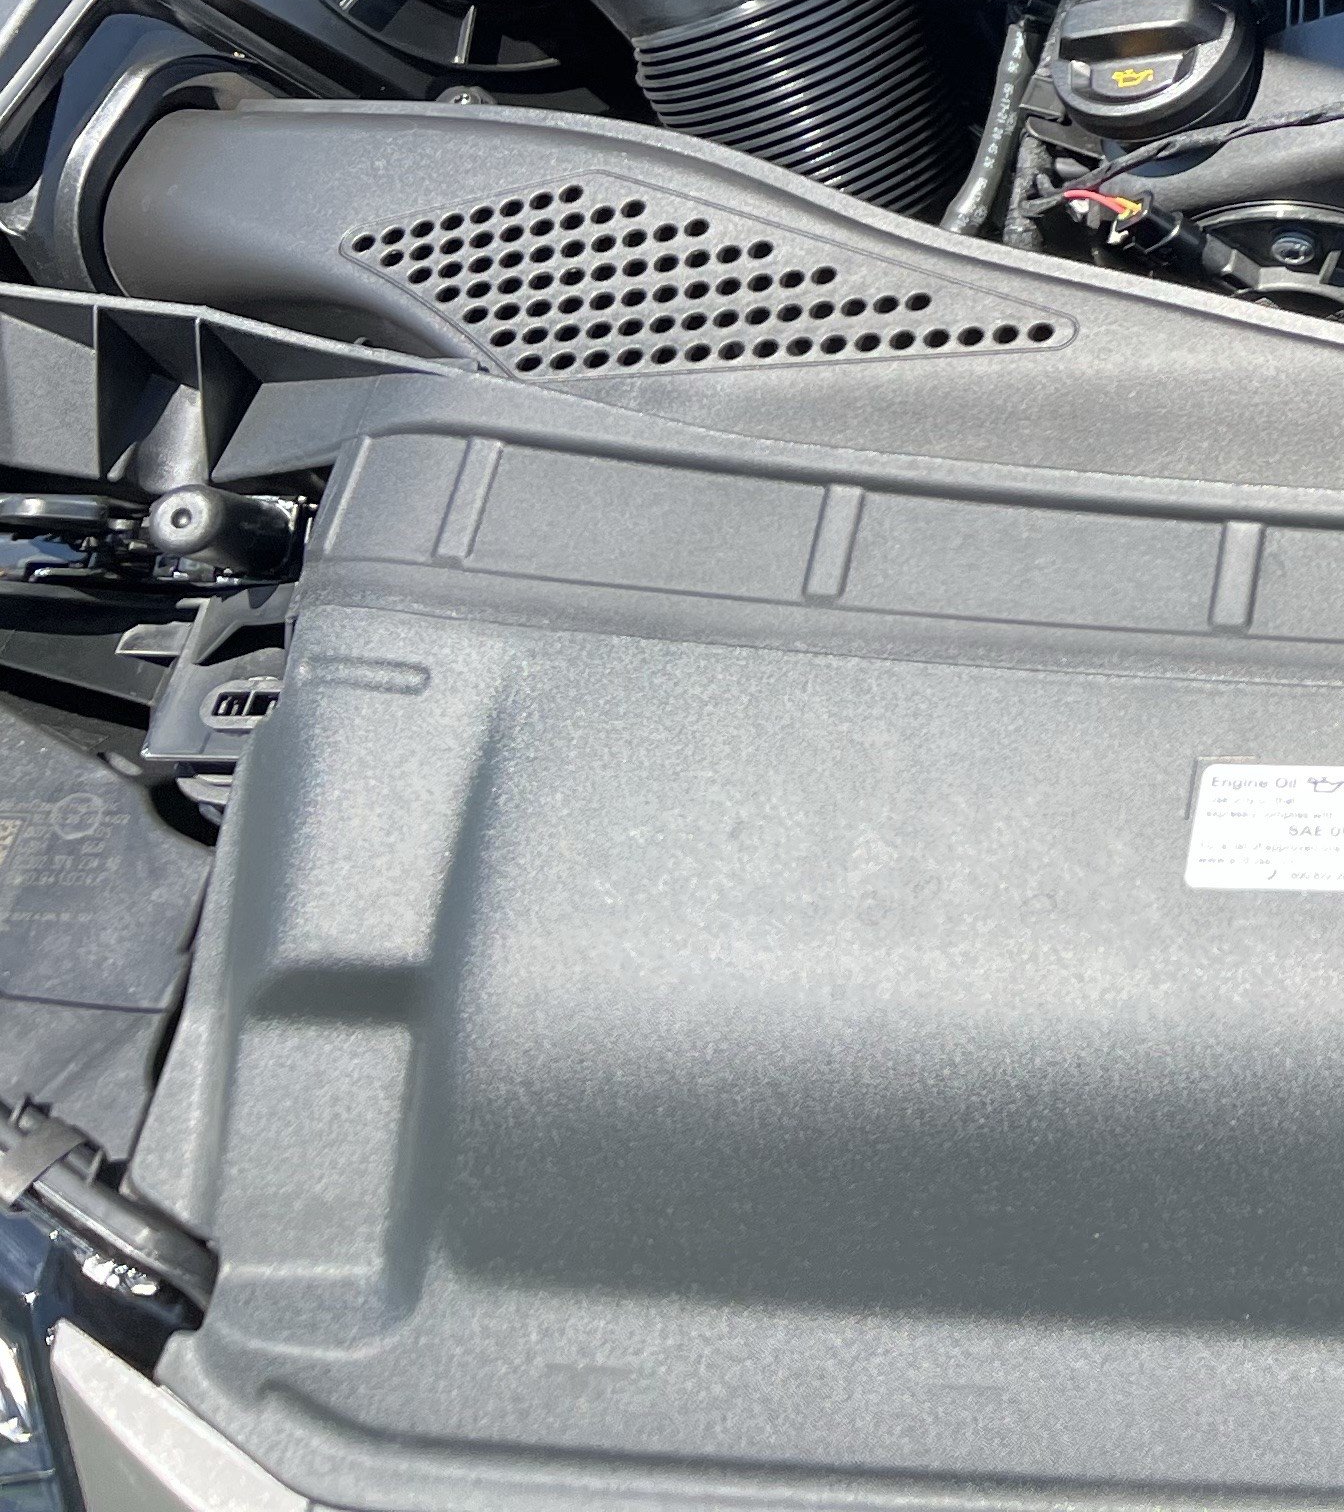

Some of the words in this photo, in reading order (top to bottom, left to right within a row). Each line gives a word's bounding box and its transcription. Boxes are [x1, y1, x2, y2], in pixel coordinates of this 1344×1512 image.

[1211, 776, 1268, 790] Engine
[1275, 777, 1297, 788] Oil
[1289, 825, 1322, 837] SAE
